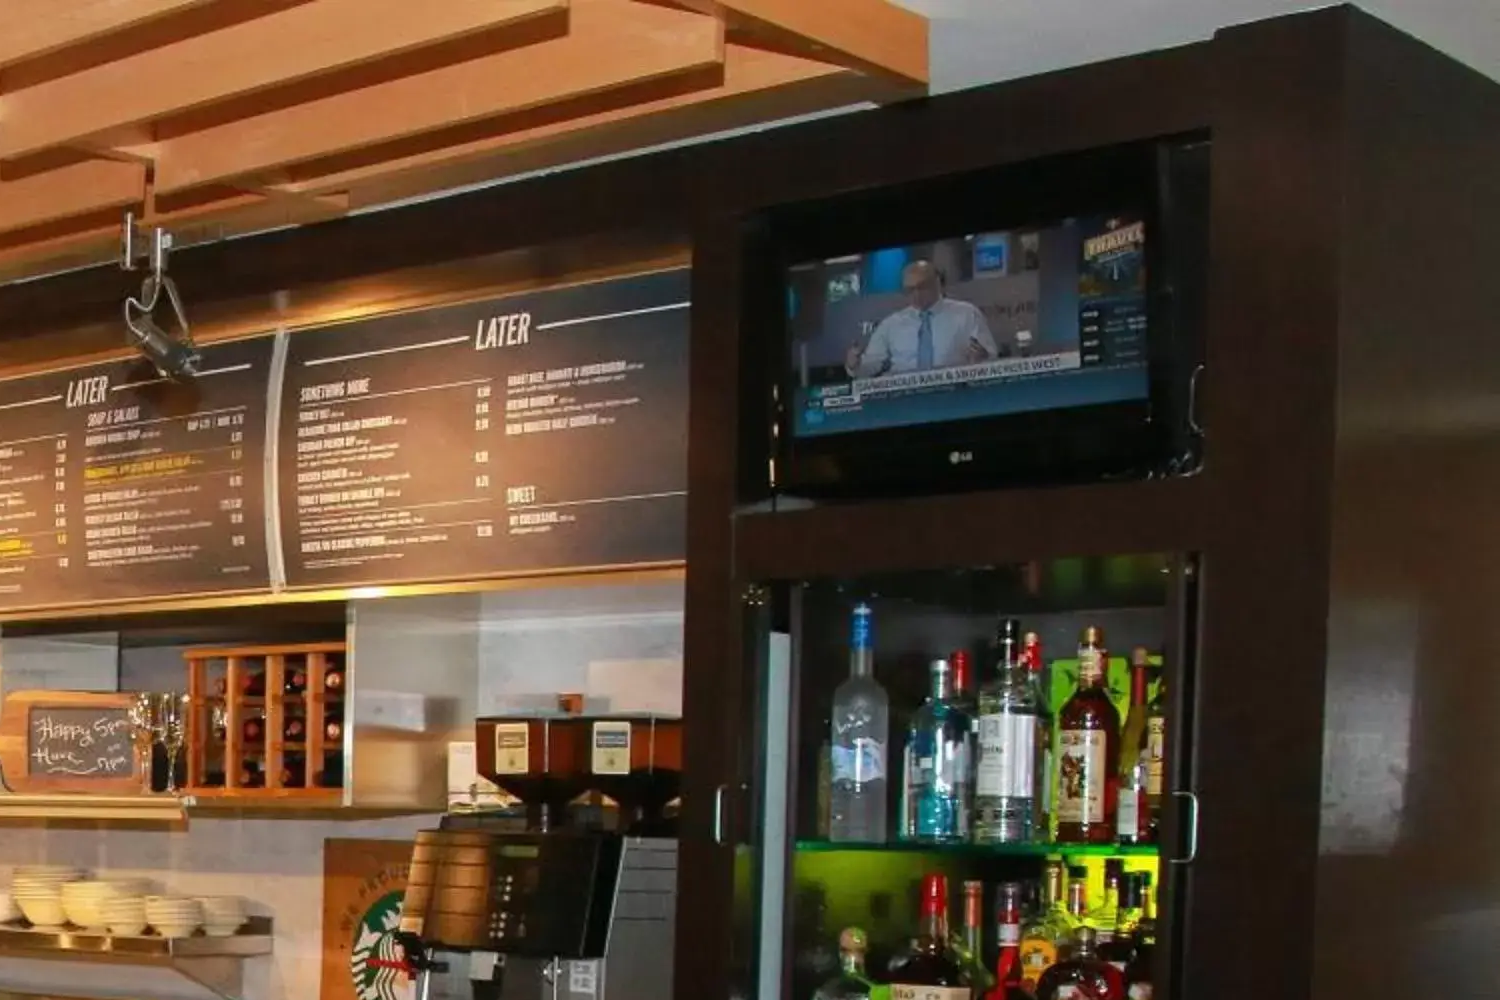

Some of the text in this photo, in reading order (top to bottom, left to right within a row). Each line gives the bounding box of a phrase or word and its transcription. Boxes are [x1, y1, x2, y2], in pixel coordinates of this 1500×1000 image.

[475, 312, 532, 351] LATER
[65, 375, 109, 409] LATER
[32, 715, 94, 747] Happy
